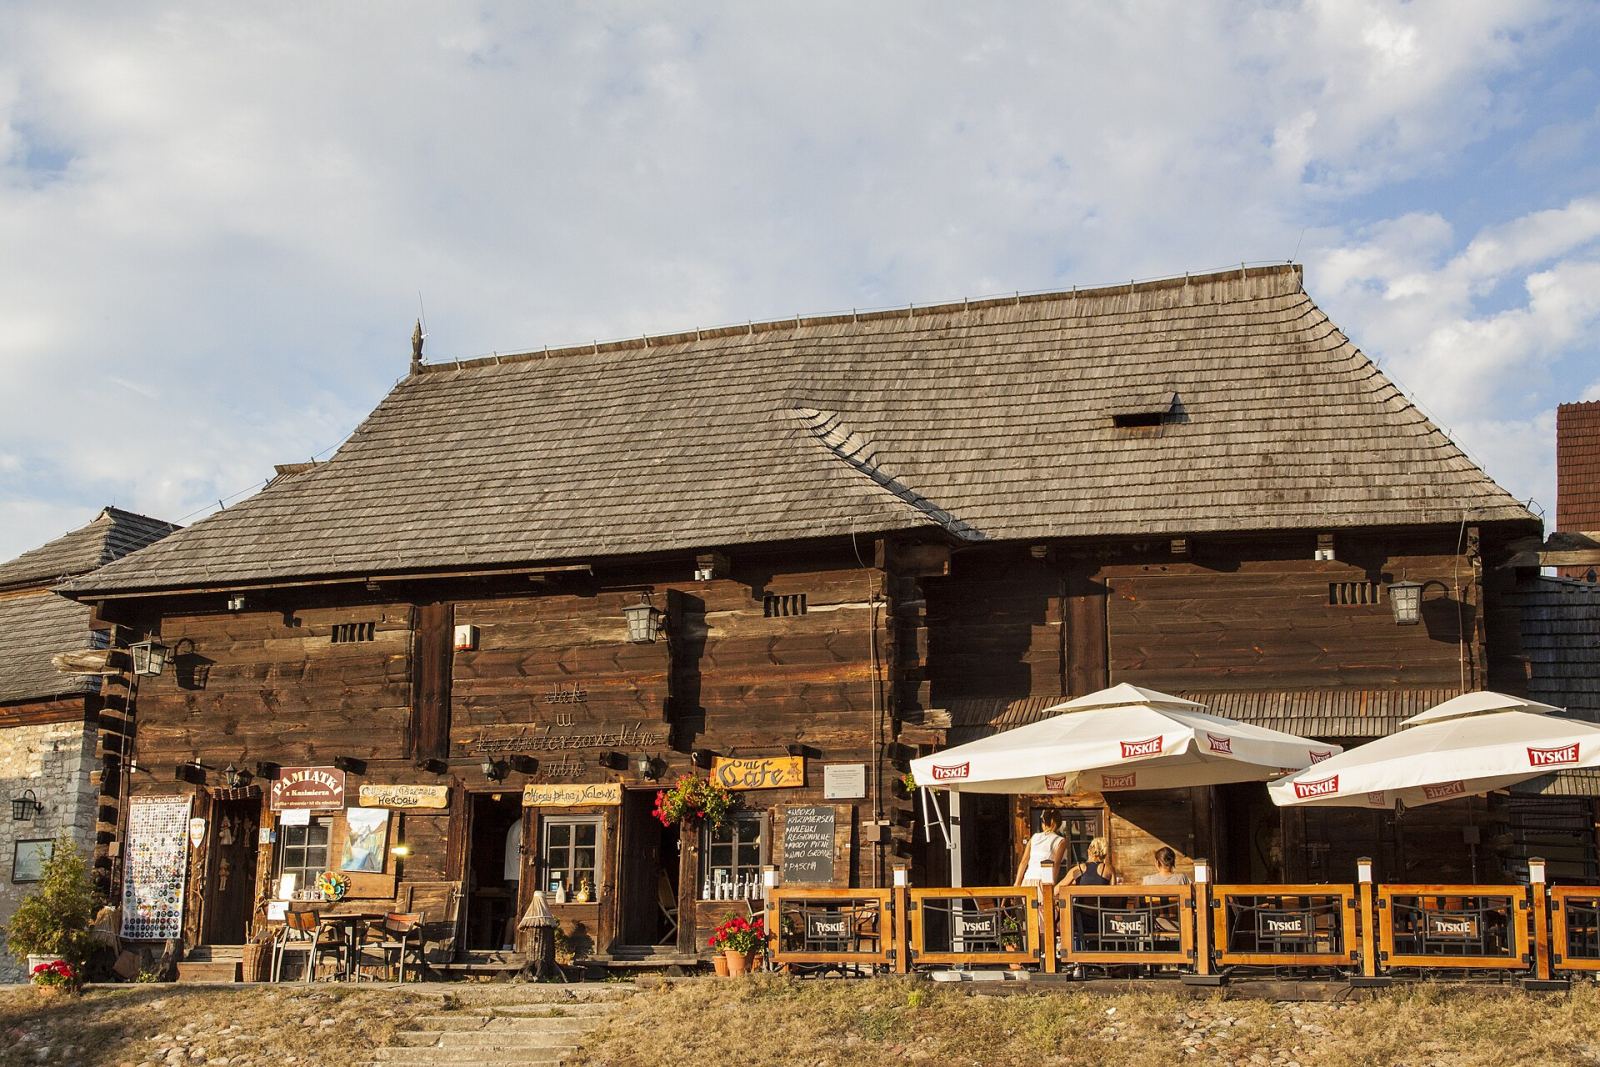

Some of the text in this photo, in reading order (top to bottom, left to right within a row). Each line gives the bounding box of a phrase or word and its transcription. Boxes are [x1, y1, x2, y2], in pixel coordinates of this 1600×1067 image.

[1124, 739, 1160, 757] TYSKIE
[1531, 747, 1577, 764] TYSKIE
[935, 765, 967, 779] TYSKIE
[273, 770, 343, 796] PAMIĄTKI
[1297, 779, 1337, 797] TYSKIE
[815, 921, 845, 932] TYSKIE
[1110, 920, 1142, 931] TYSKIE
[1267, 919, 1302, 931] TYSKIE
[1435, 921, 1471, 932] TYSKIE
